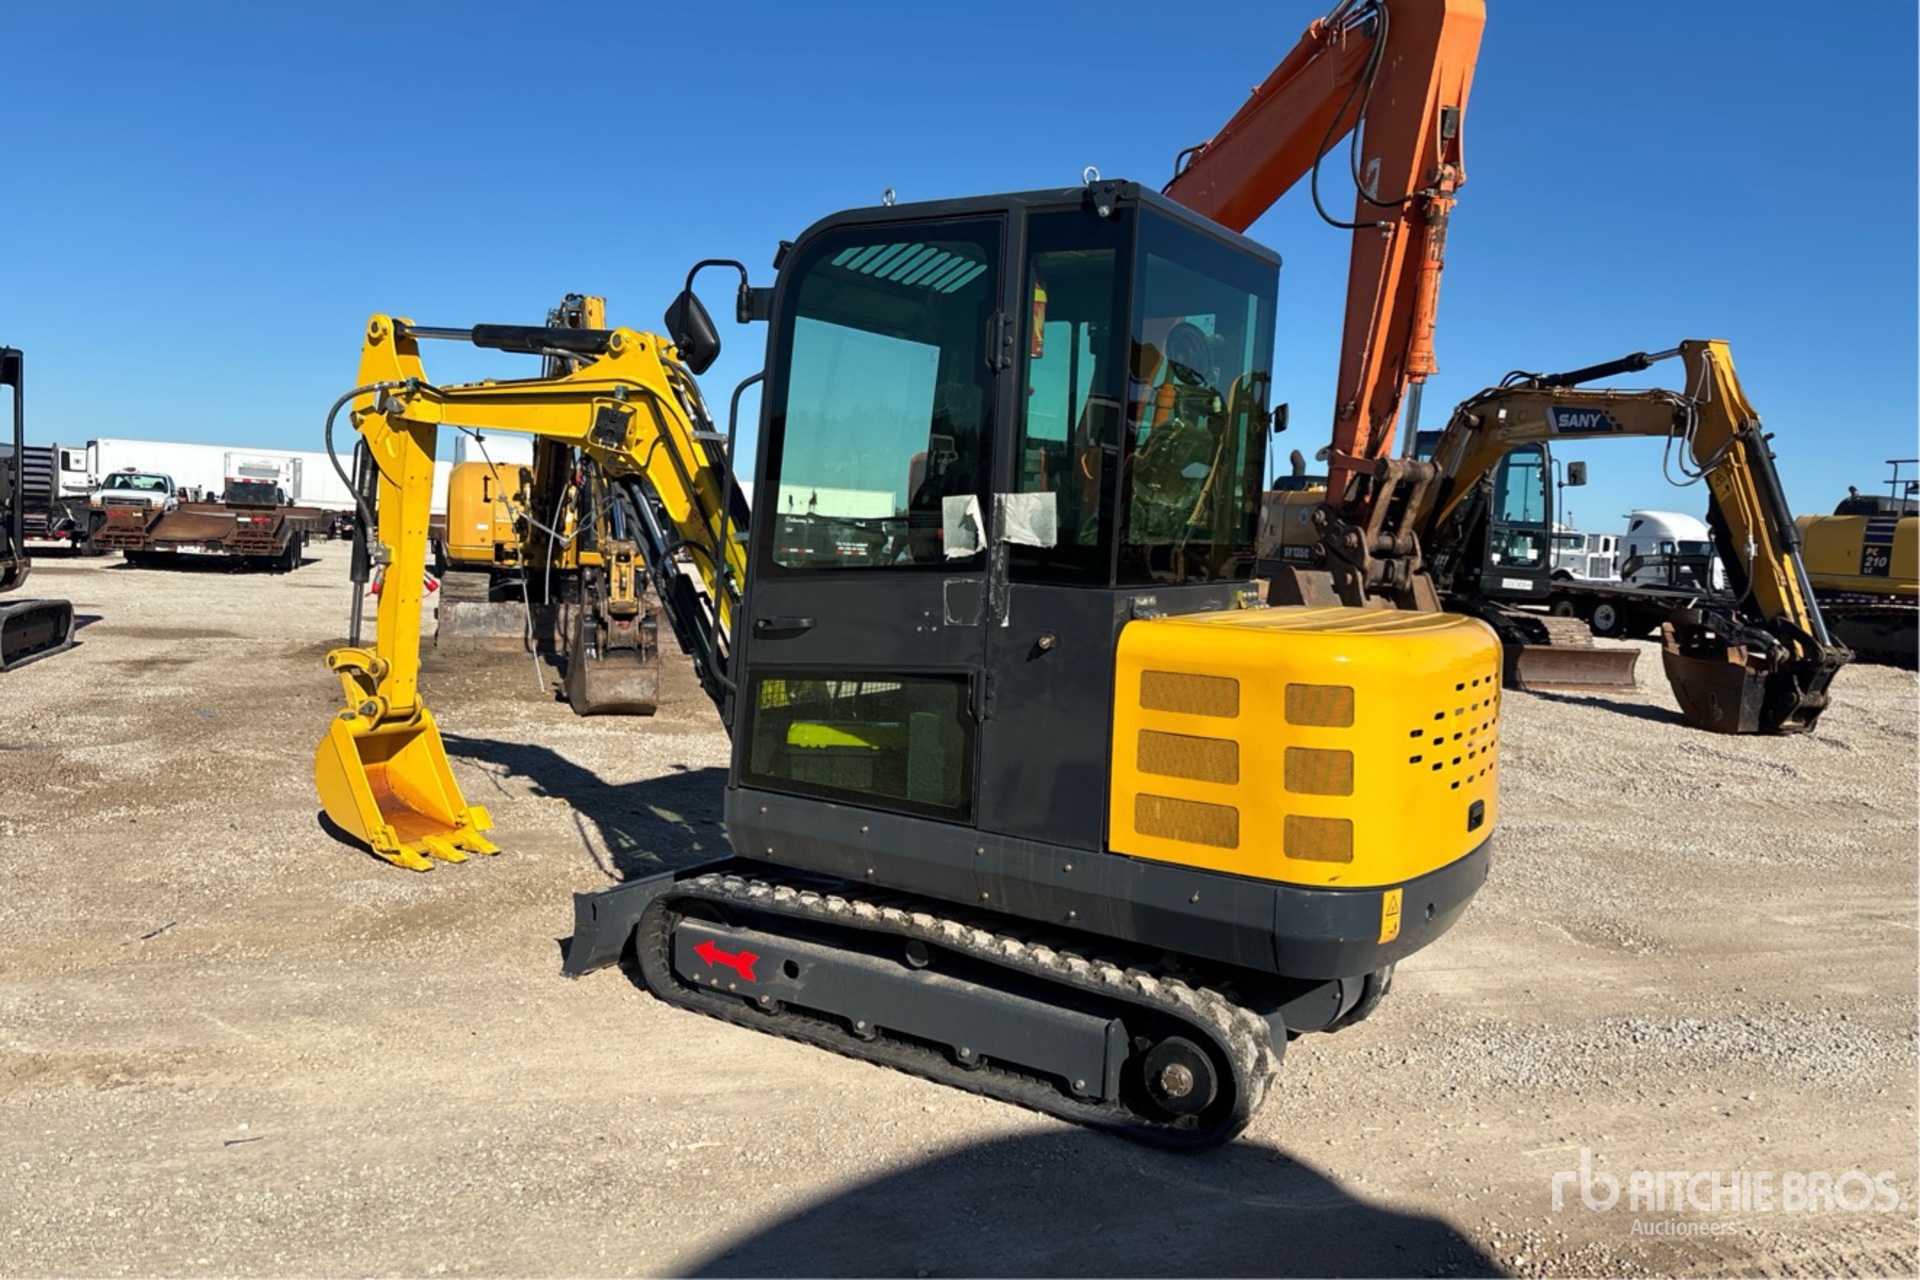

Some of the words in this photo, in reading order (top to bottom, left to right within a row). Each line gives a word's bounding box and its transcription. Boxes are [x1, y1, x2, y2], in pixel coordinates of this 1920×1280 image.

[1558, 413, 1601, 428] SANY
[1866, 547, 1879, 556] PC
[1864, 556, 1887, 567] 210
